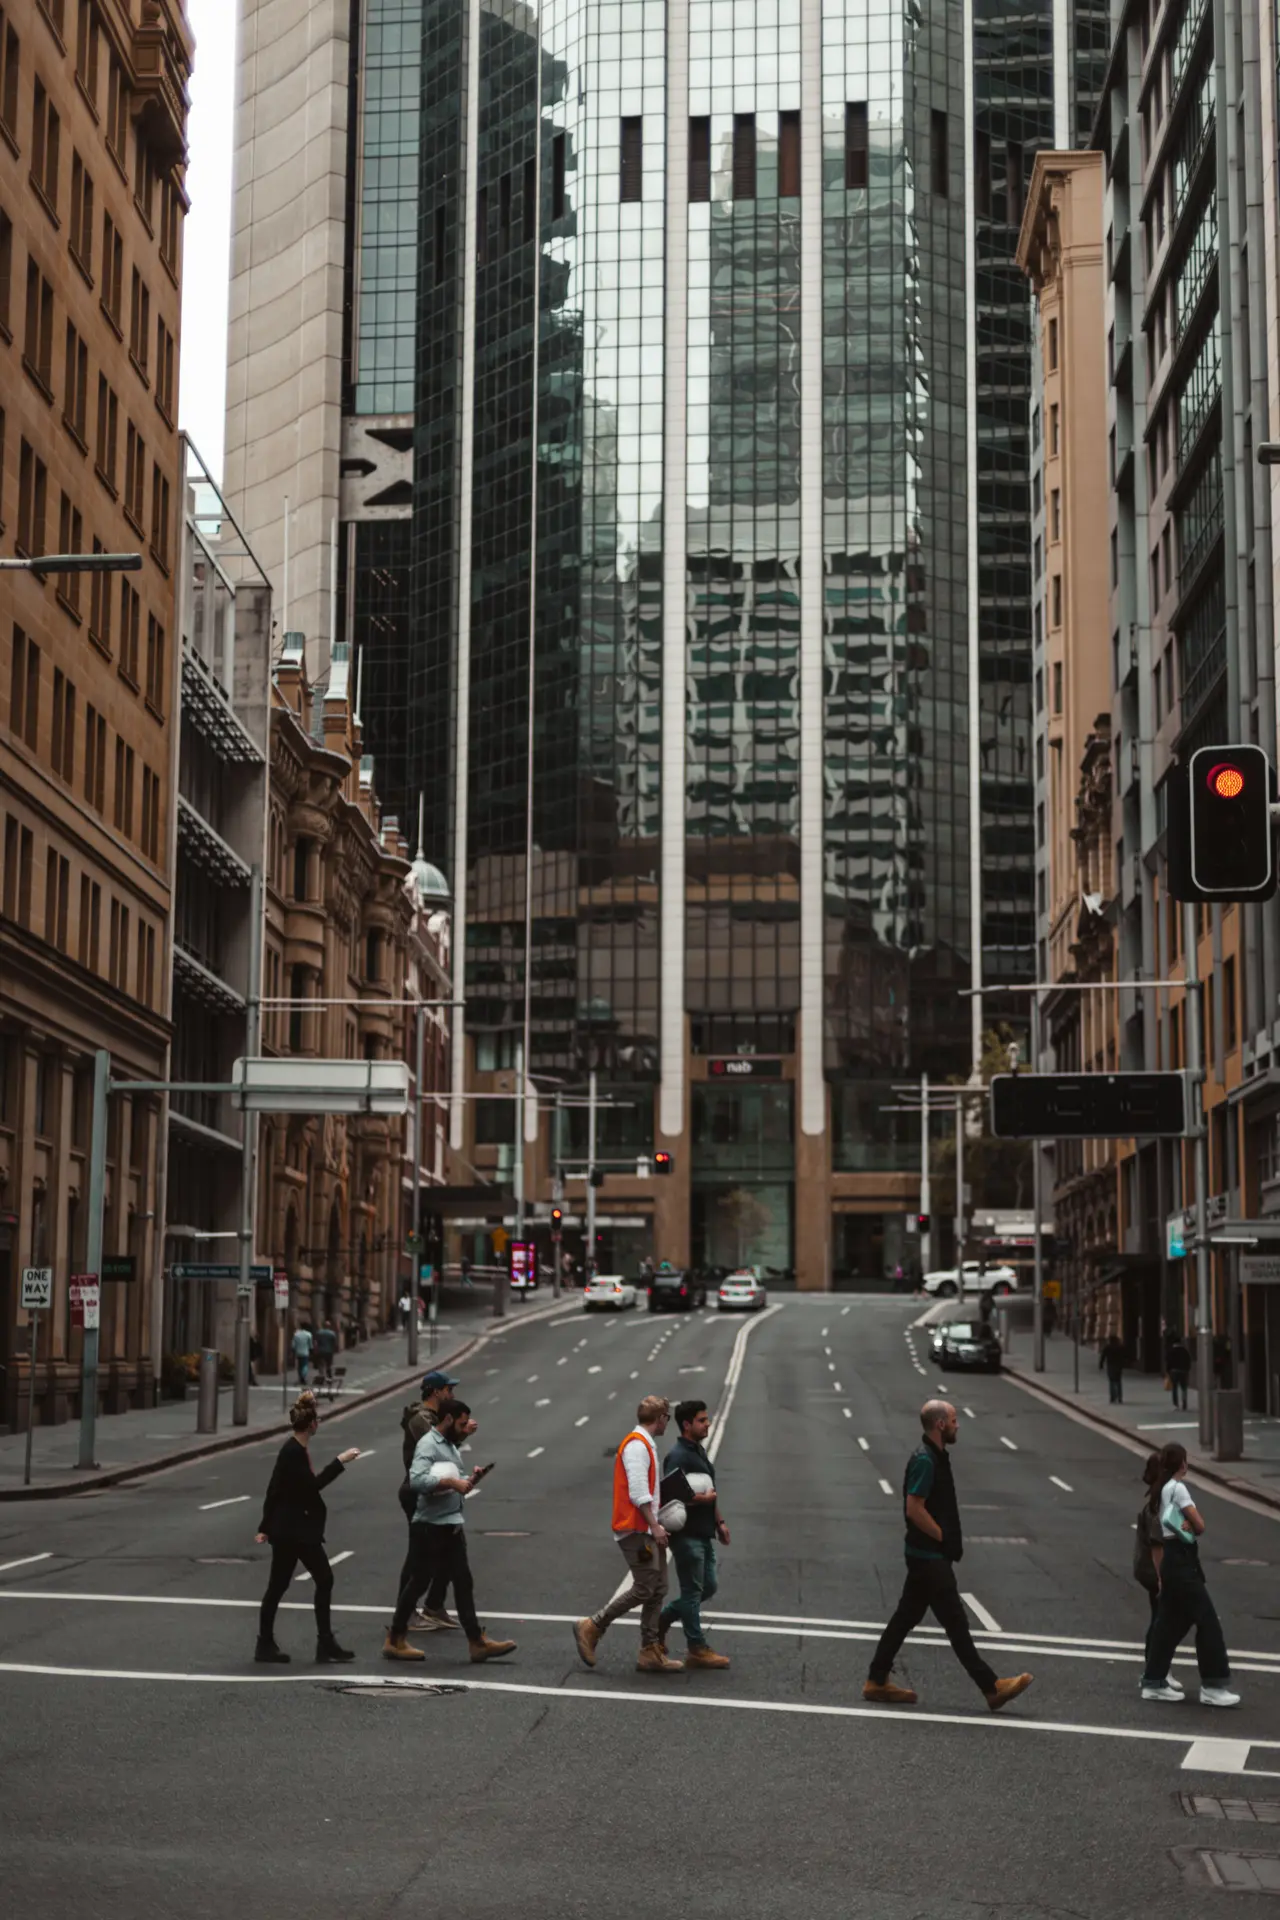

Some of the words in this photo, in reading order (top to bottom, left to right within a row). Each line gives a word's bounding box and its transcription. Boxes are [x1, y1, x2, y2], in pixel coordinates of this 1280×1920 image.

[726, 1060, 752, 1073] nab
[26, 1271, 48, 1281] ONE
[24, 1283, 49, 1293] WAY
